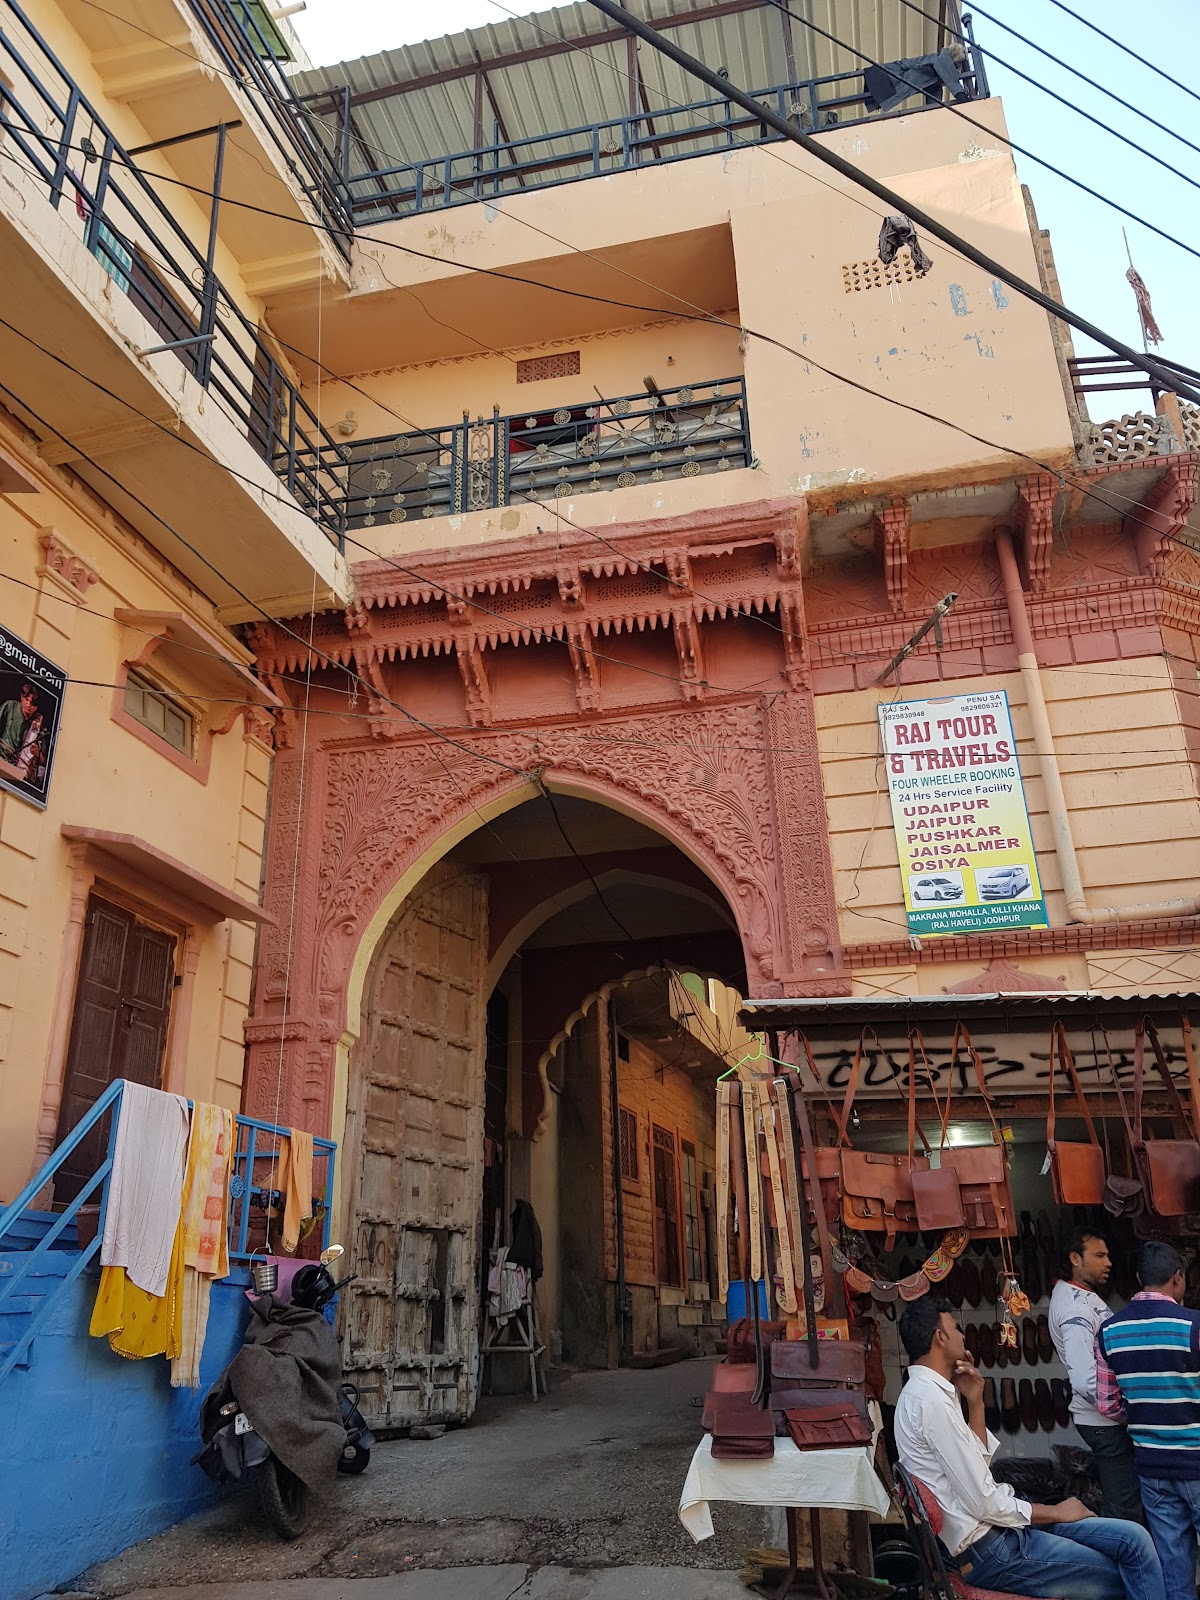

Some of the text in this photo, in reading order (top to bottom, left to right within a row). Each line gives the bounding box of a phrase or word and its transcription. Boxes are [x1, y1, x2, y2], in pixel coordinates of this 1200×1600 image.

[960, 702, 1003, 712] 9829806321
[966, 696, 988, 704] PENU
[894, 714, 998, 746] RAJ TOUR
[890, 740, 1011, 774] & TRAVELS
[892, 767, 1016, 790] FOUR WHEELER BOOKING
[898, 783, 1013, 802] 24 Hrs Service Facility
[903, 799, 990, 817] UDAIPUR
[905, 814, 976, 831] JAIPUR
[907, 825, 1002, 844] PUSHKAR
[909, 838, 1021, 858] JAISALMER
[910, 857, 970, 872] OSIYA
[909, 903, 1042, 922] MAKRANA MOHALLA, KILLI KHANA
[931, 914, 1021, 930] (RAJ HAVELI) JODHPUR
